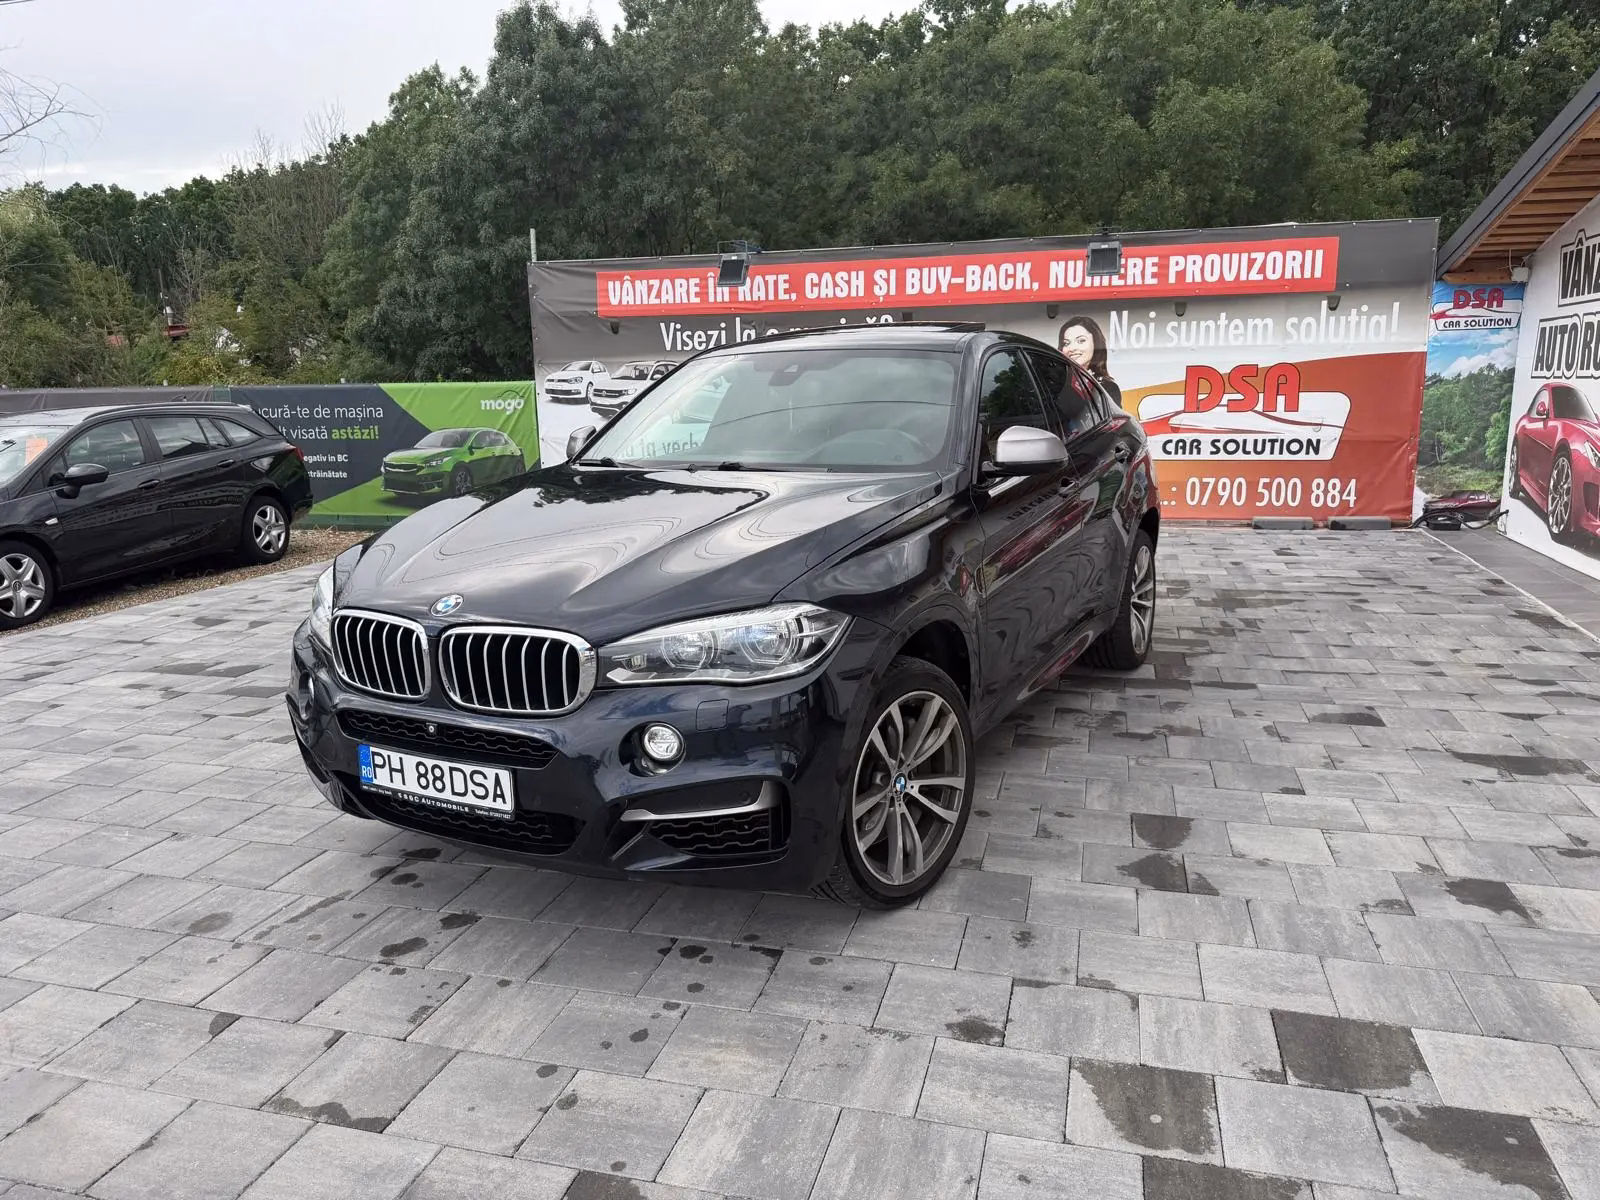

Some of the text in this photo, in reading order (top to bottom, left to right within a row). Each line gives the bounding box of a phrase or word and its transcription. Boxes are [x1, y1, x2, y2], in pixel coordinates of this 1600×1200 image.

[608, 275, 700, 305] VÂNZARE
[738, 274, 796, 302] RATE,
[804, 270, 865, 299] CASH
[873, 268, 897, 302] ȘI
[905, 262, 1039, 295] BUY-BACK,
[1169, 248, 1325, 284] PROVIZORII
[1453, 287, 1505, 309] DSA
[1109, 311, 1157, 349] Noi
[1166, 313, 1274, 346] suntem
[1443, 318, 1512, 329] CAR SOLUTION
[660, 320, 726, 351] Visezi
[1184, 363, 1300, 413] DSA
[313, 404, 331, 418] de
[334, 404, 384, 422] mașina
[480, 399, 524, 415] mogo
[290, 426, 328, 439] visată
[331, 425, 380, 440] astăzi!
[1161, 438, 1321, 456] CAR SOLUTION
[302, 454, 327, 463] egativ
[337, 454, 349, 462] BC
[1185, 477, 1247, 507] 0790
[1255, 478, 1301, 507] 500
[1310, 478, 1357, 508] 884
[361, 765, 373, 778] RO
[370, 750, 406, 786] PH
[421, 797, 469, 812] AUTOMOBILE
